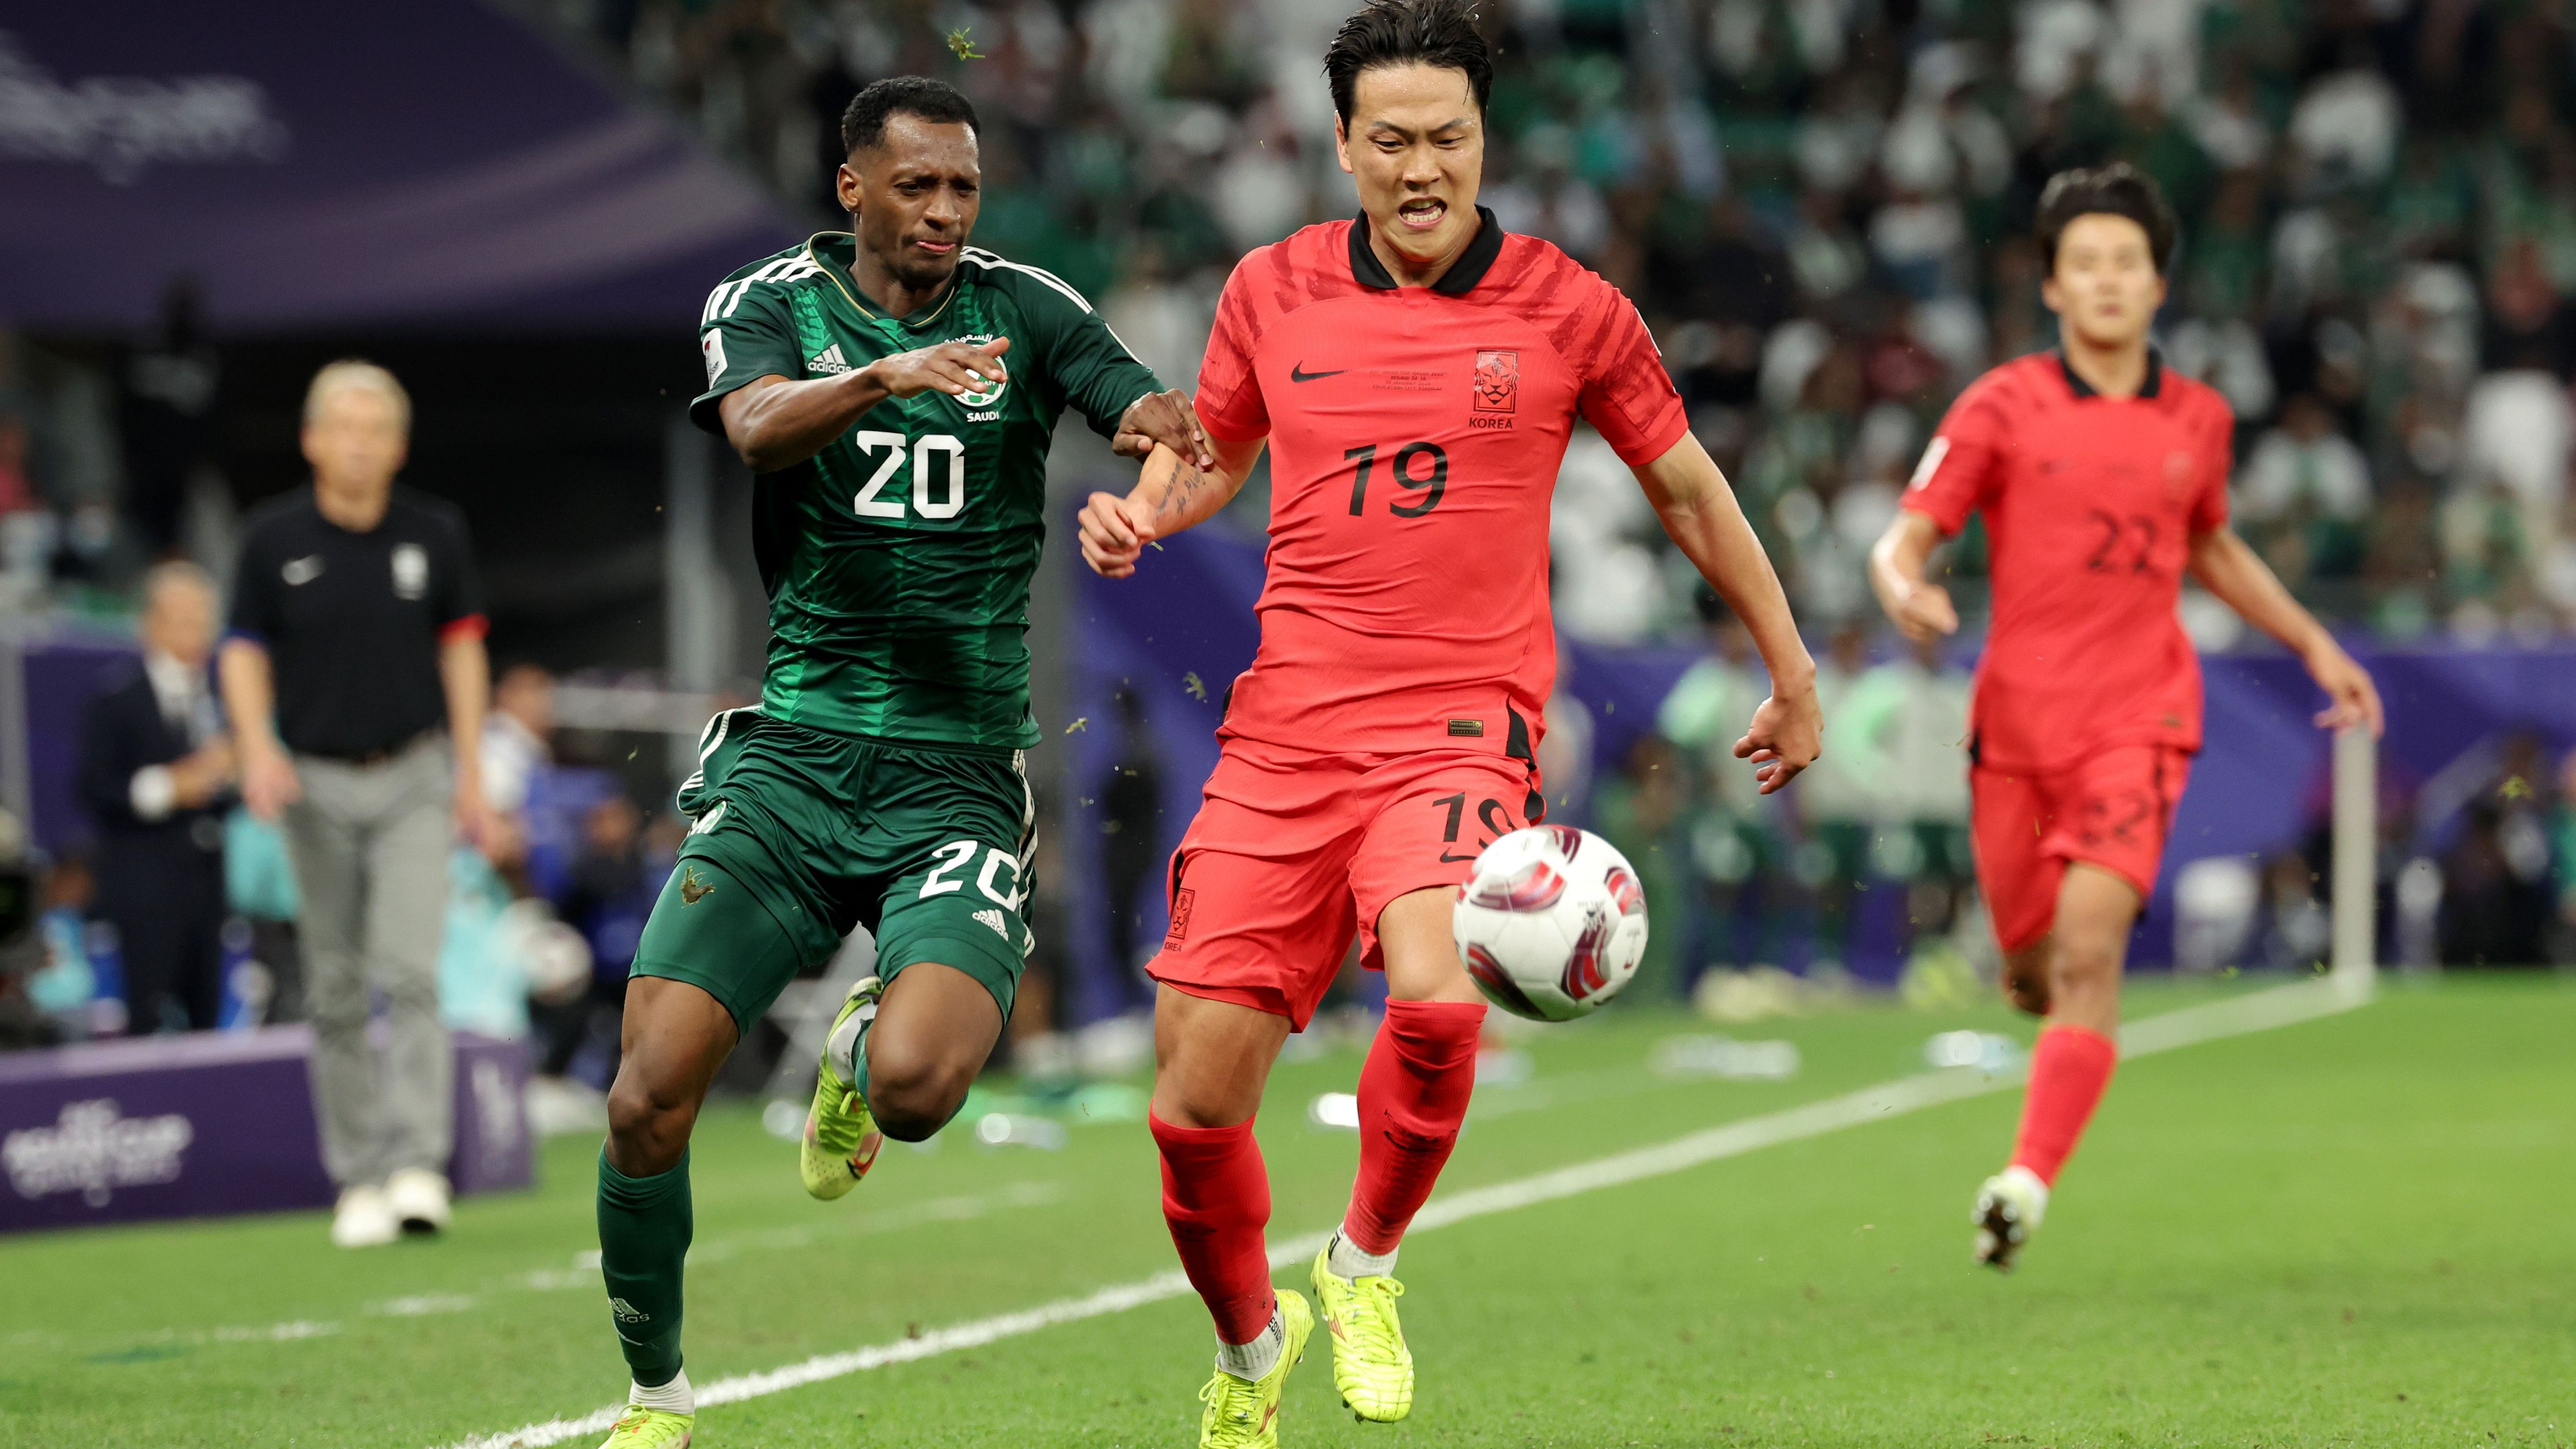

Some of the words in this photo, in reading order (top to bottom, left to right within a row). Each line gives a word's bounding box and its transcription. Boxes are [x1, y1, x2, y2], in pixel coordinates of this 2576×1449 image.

[808, 361, 852, 374] adidas
[967, 411, 1000, 422] SAUDI
[1469, 417, 1513, 430] KOREA
[854, 430, 965, 519] 20
[1343, 441, 1448, 518] 19
[2086, 510, 2159, 578] 22
[919, 840, 1021, 912] 20
